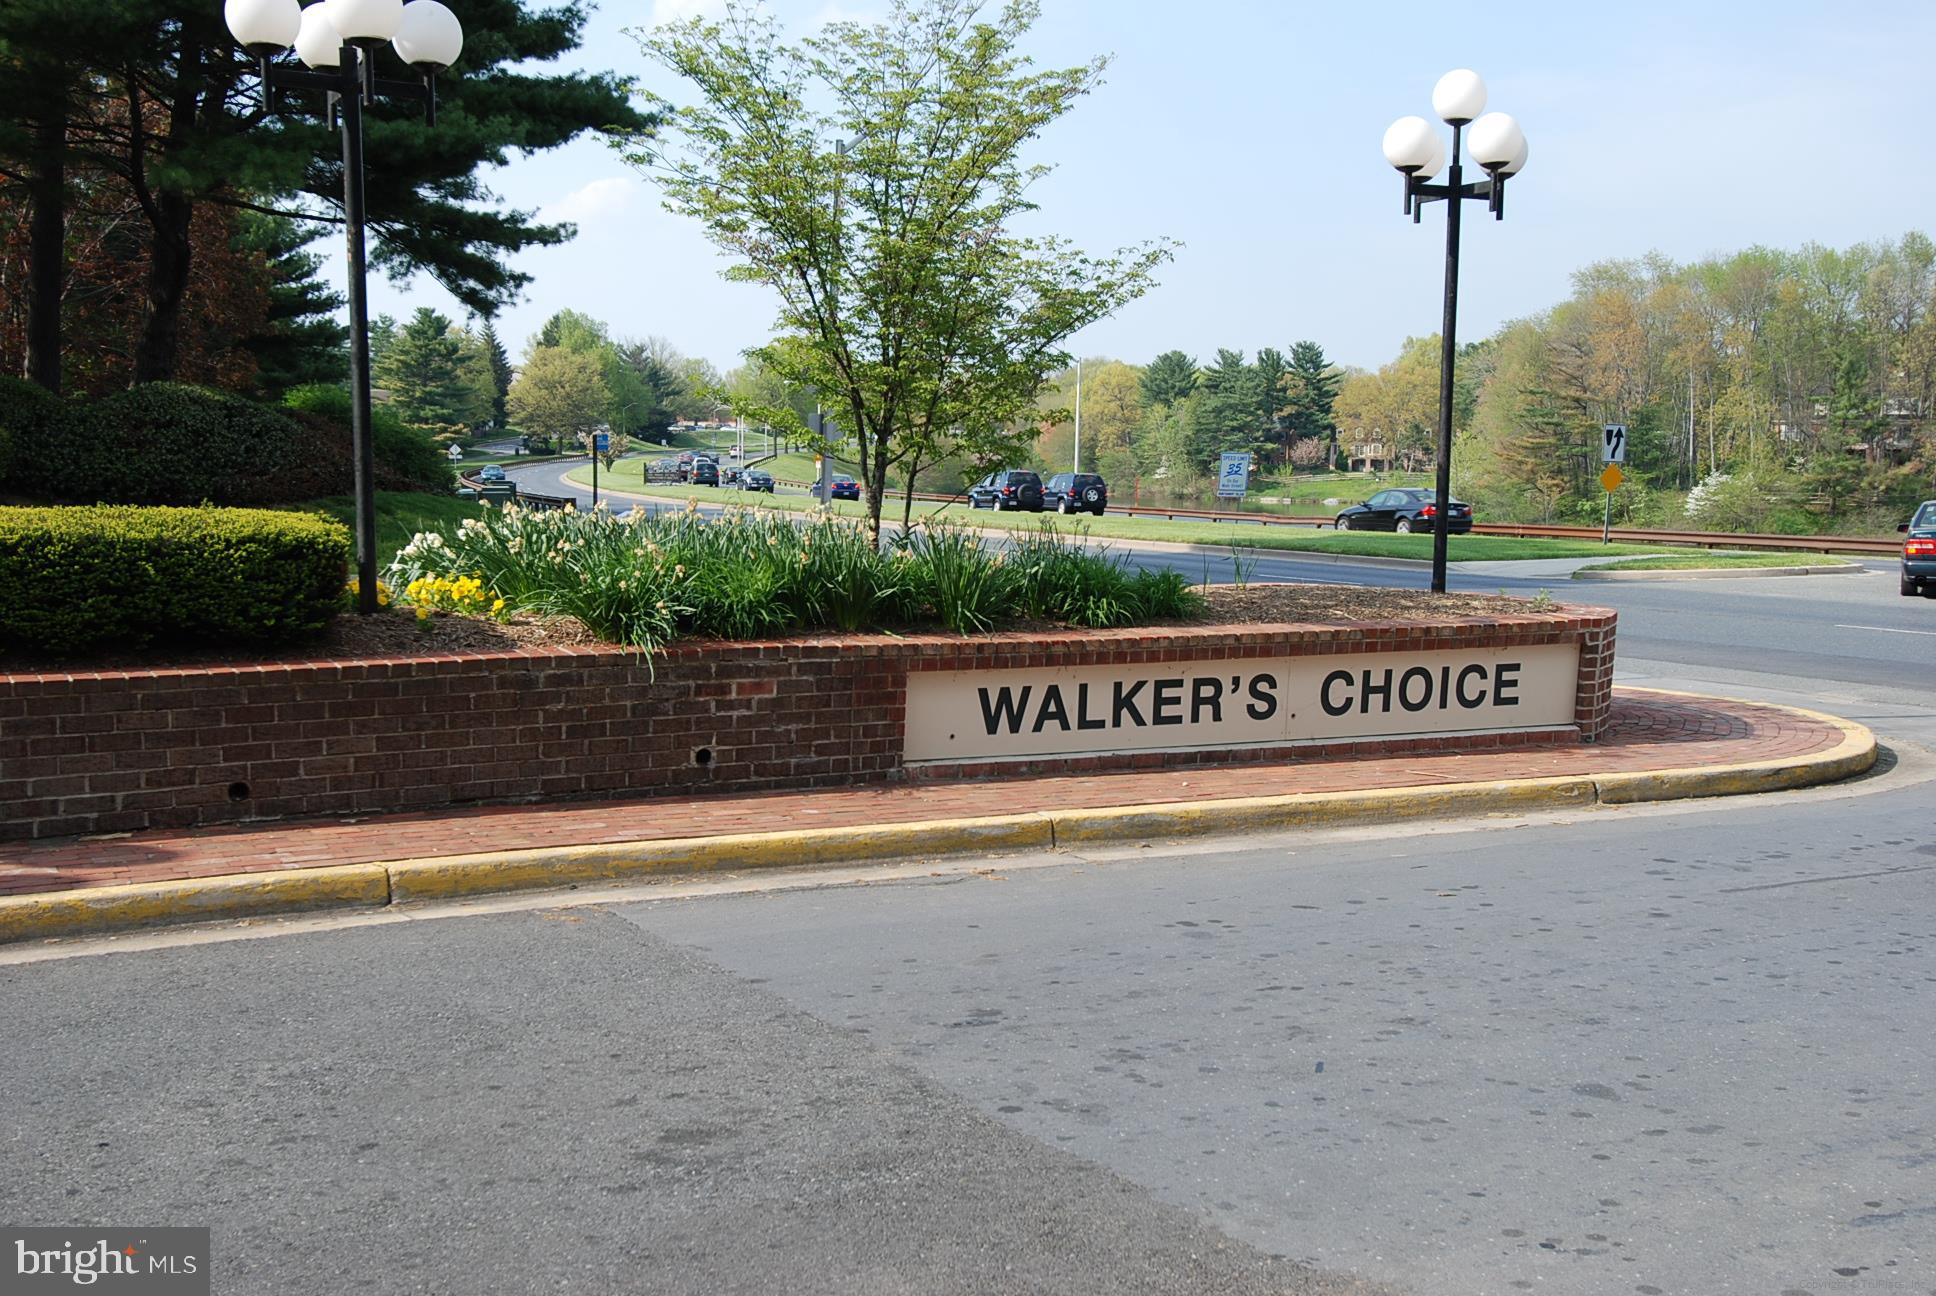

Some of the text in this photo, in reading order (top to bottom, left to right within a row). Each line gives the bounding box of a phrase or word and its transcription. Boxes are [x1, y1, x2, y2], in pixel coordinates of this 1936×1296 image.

[1226, 462, 1243, 476] 35
[977, 662, 1522, 736] WALKER'S CHOICE
